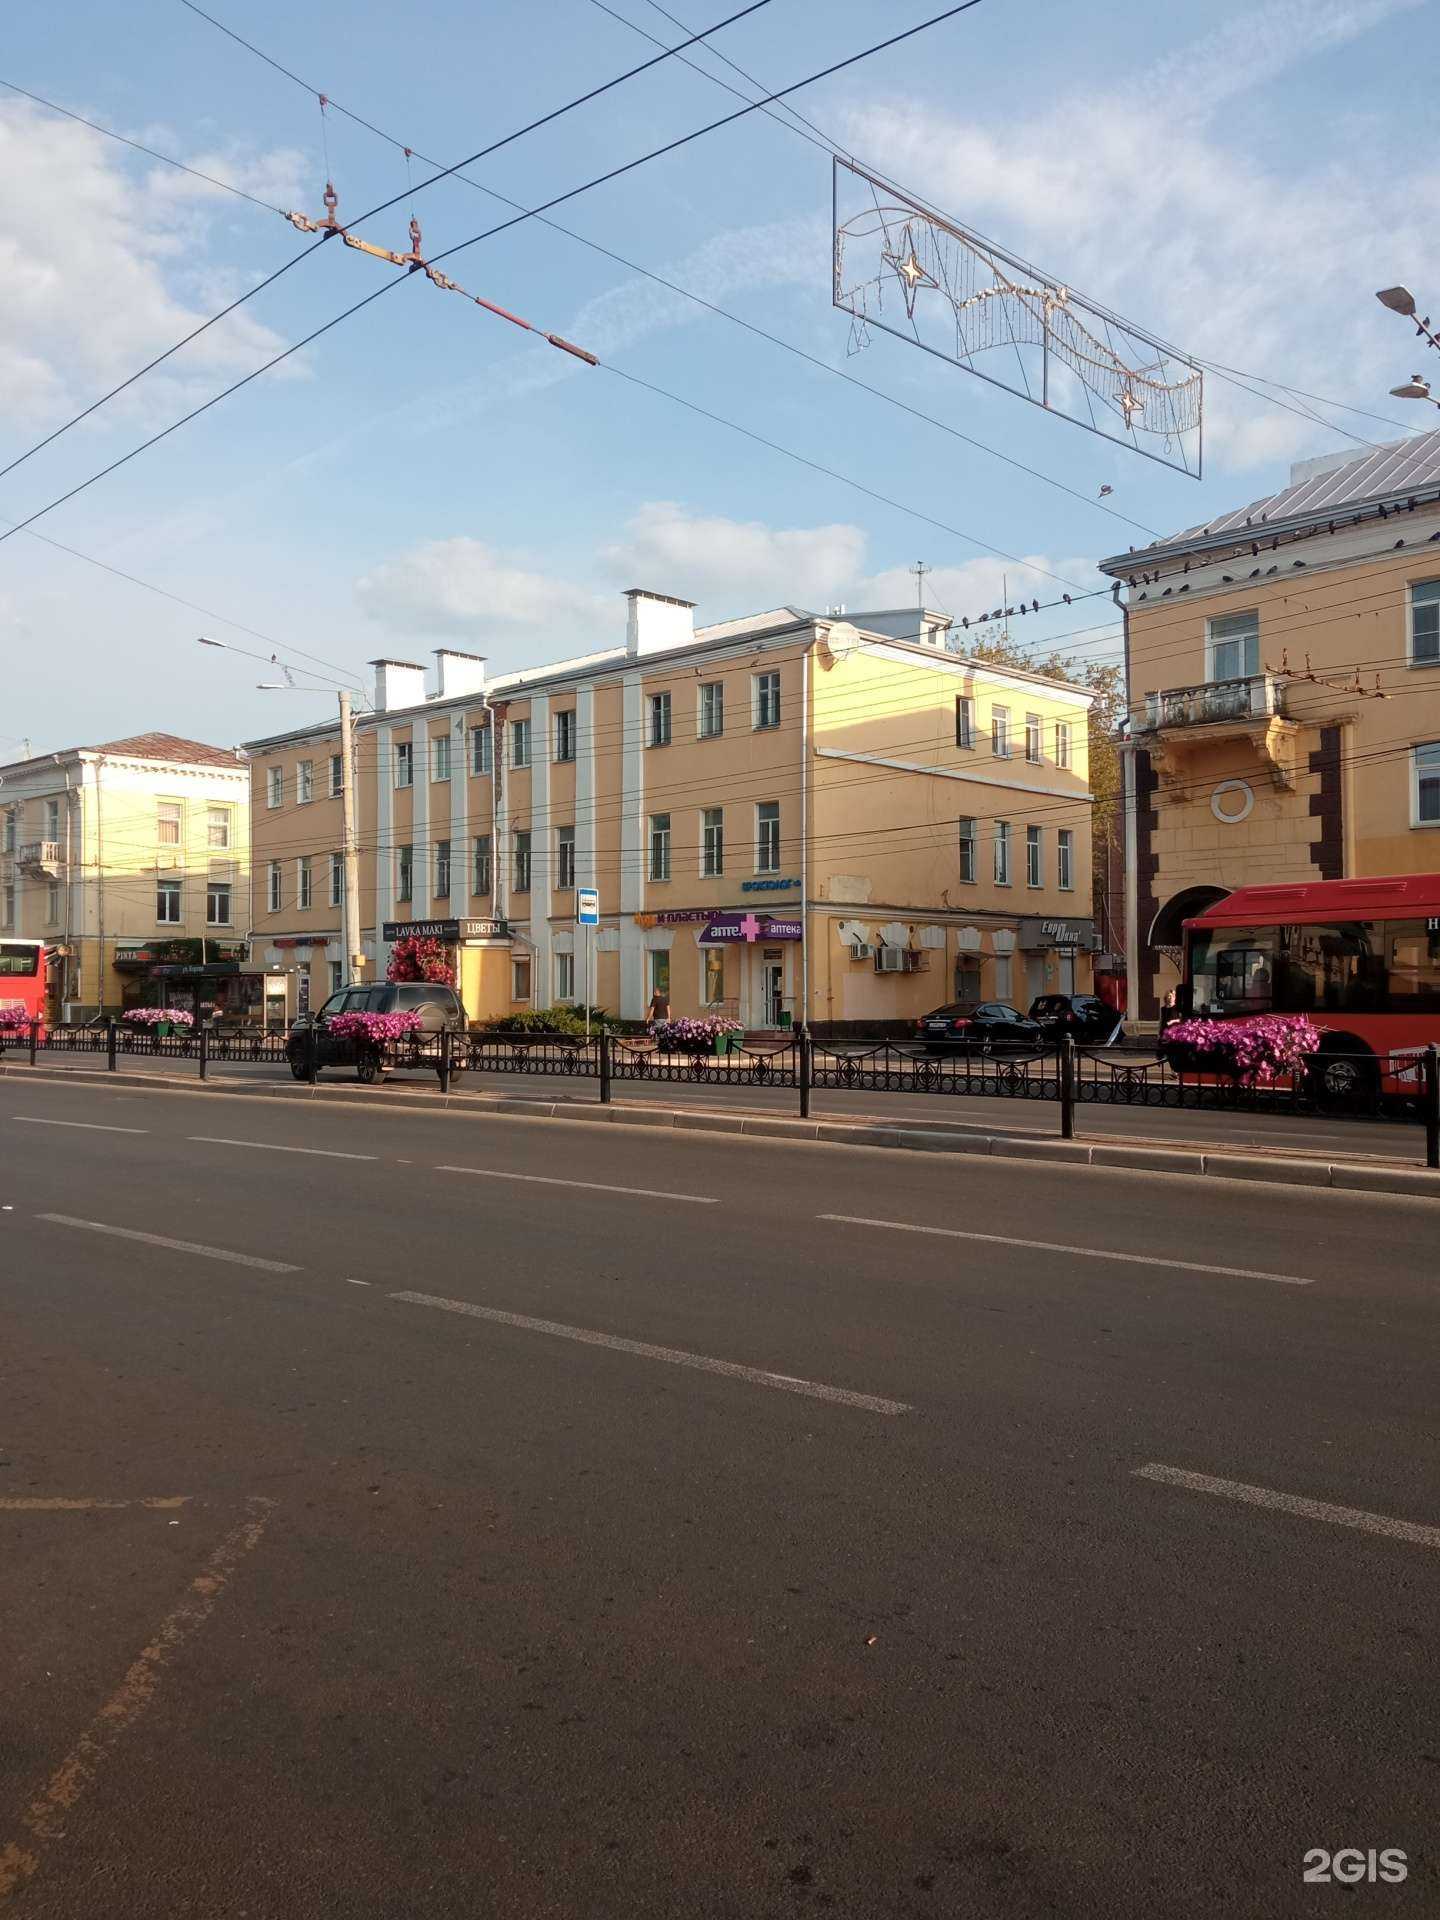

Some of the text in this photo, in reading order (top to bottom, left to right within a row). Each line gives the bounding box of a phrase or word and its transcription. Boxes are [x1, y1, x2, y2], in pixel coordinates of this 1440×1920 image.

[396, 926, 421, 937] LAVKA
[422, 924, 443, 936] MAKI
[466, 923, 500, 935] ЦВЕТЫ
[711, 926, 745, 937] апте
[770, 925, 801, 934] аптека
